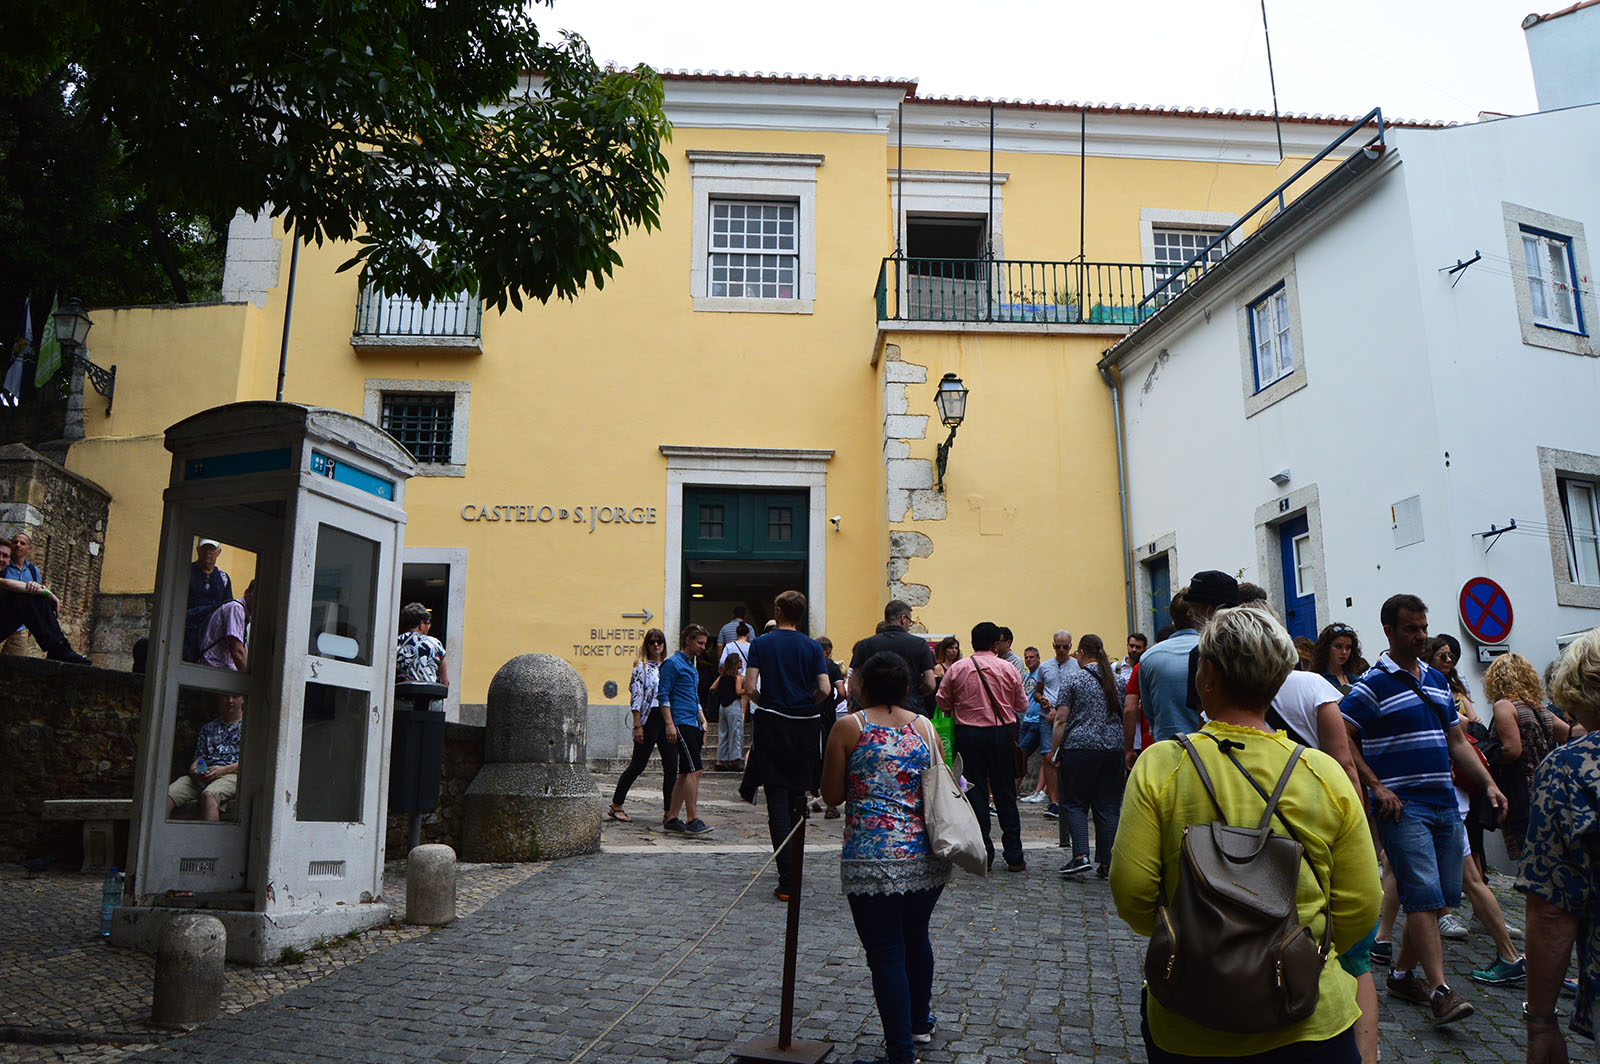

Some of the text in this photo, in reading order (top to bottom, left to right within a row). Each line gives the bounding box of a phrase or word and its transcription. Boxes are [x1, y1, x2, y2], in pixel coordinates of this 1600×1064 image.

[461, 504, 555, 522] CASTELO
[573, 506, 587, 523] S.
[589, 506, 657, 534] JORGE
[591, 628, 646, 640] BILHETEIR
[573, 645, 642, 656] TICKET OFFI
